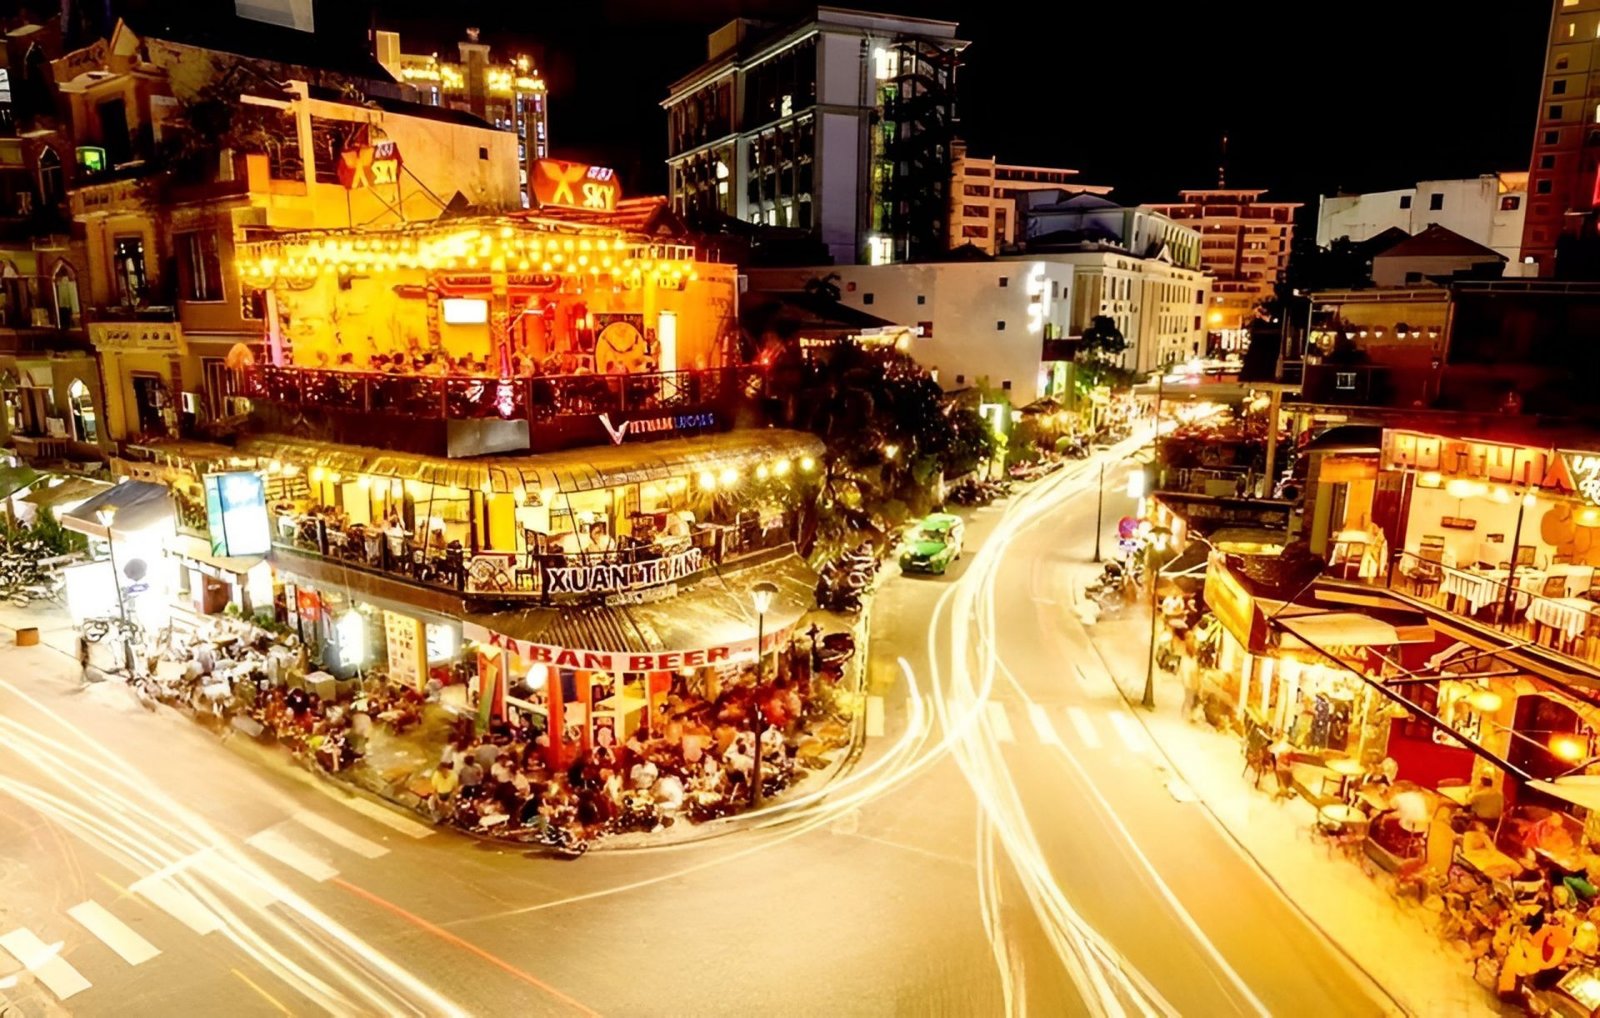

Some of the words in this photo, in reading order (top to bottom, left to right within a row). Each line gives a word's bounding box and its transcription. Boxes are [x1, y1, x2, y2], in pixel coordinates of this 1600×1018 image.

[546, 563, 630, 594] XUAN
[529, 644, 613, 671] BAN
[629, 646, 730, 672] BEER
